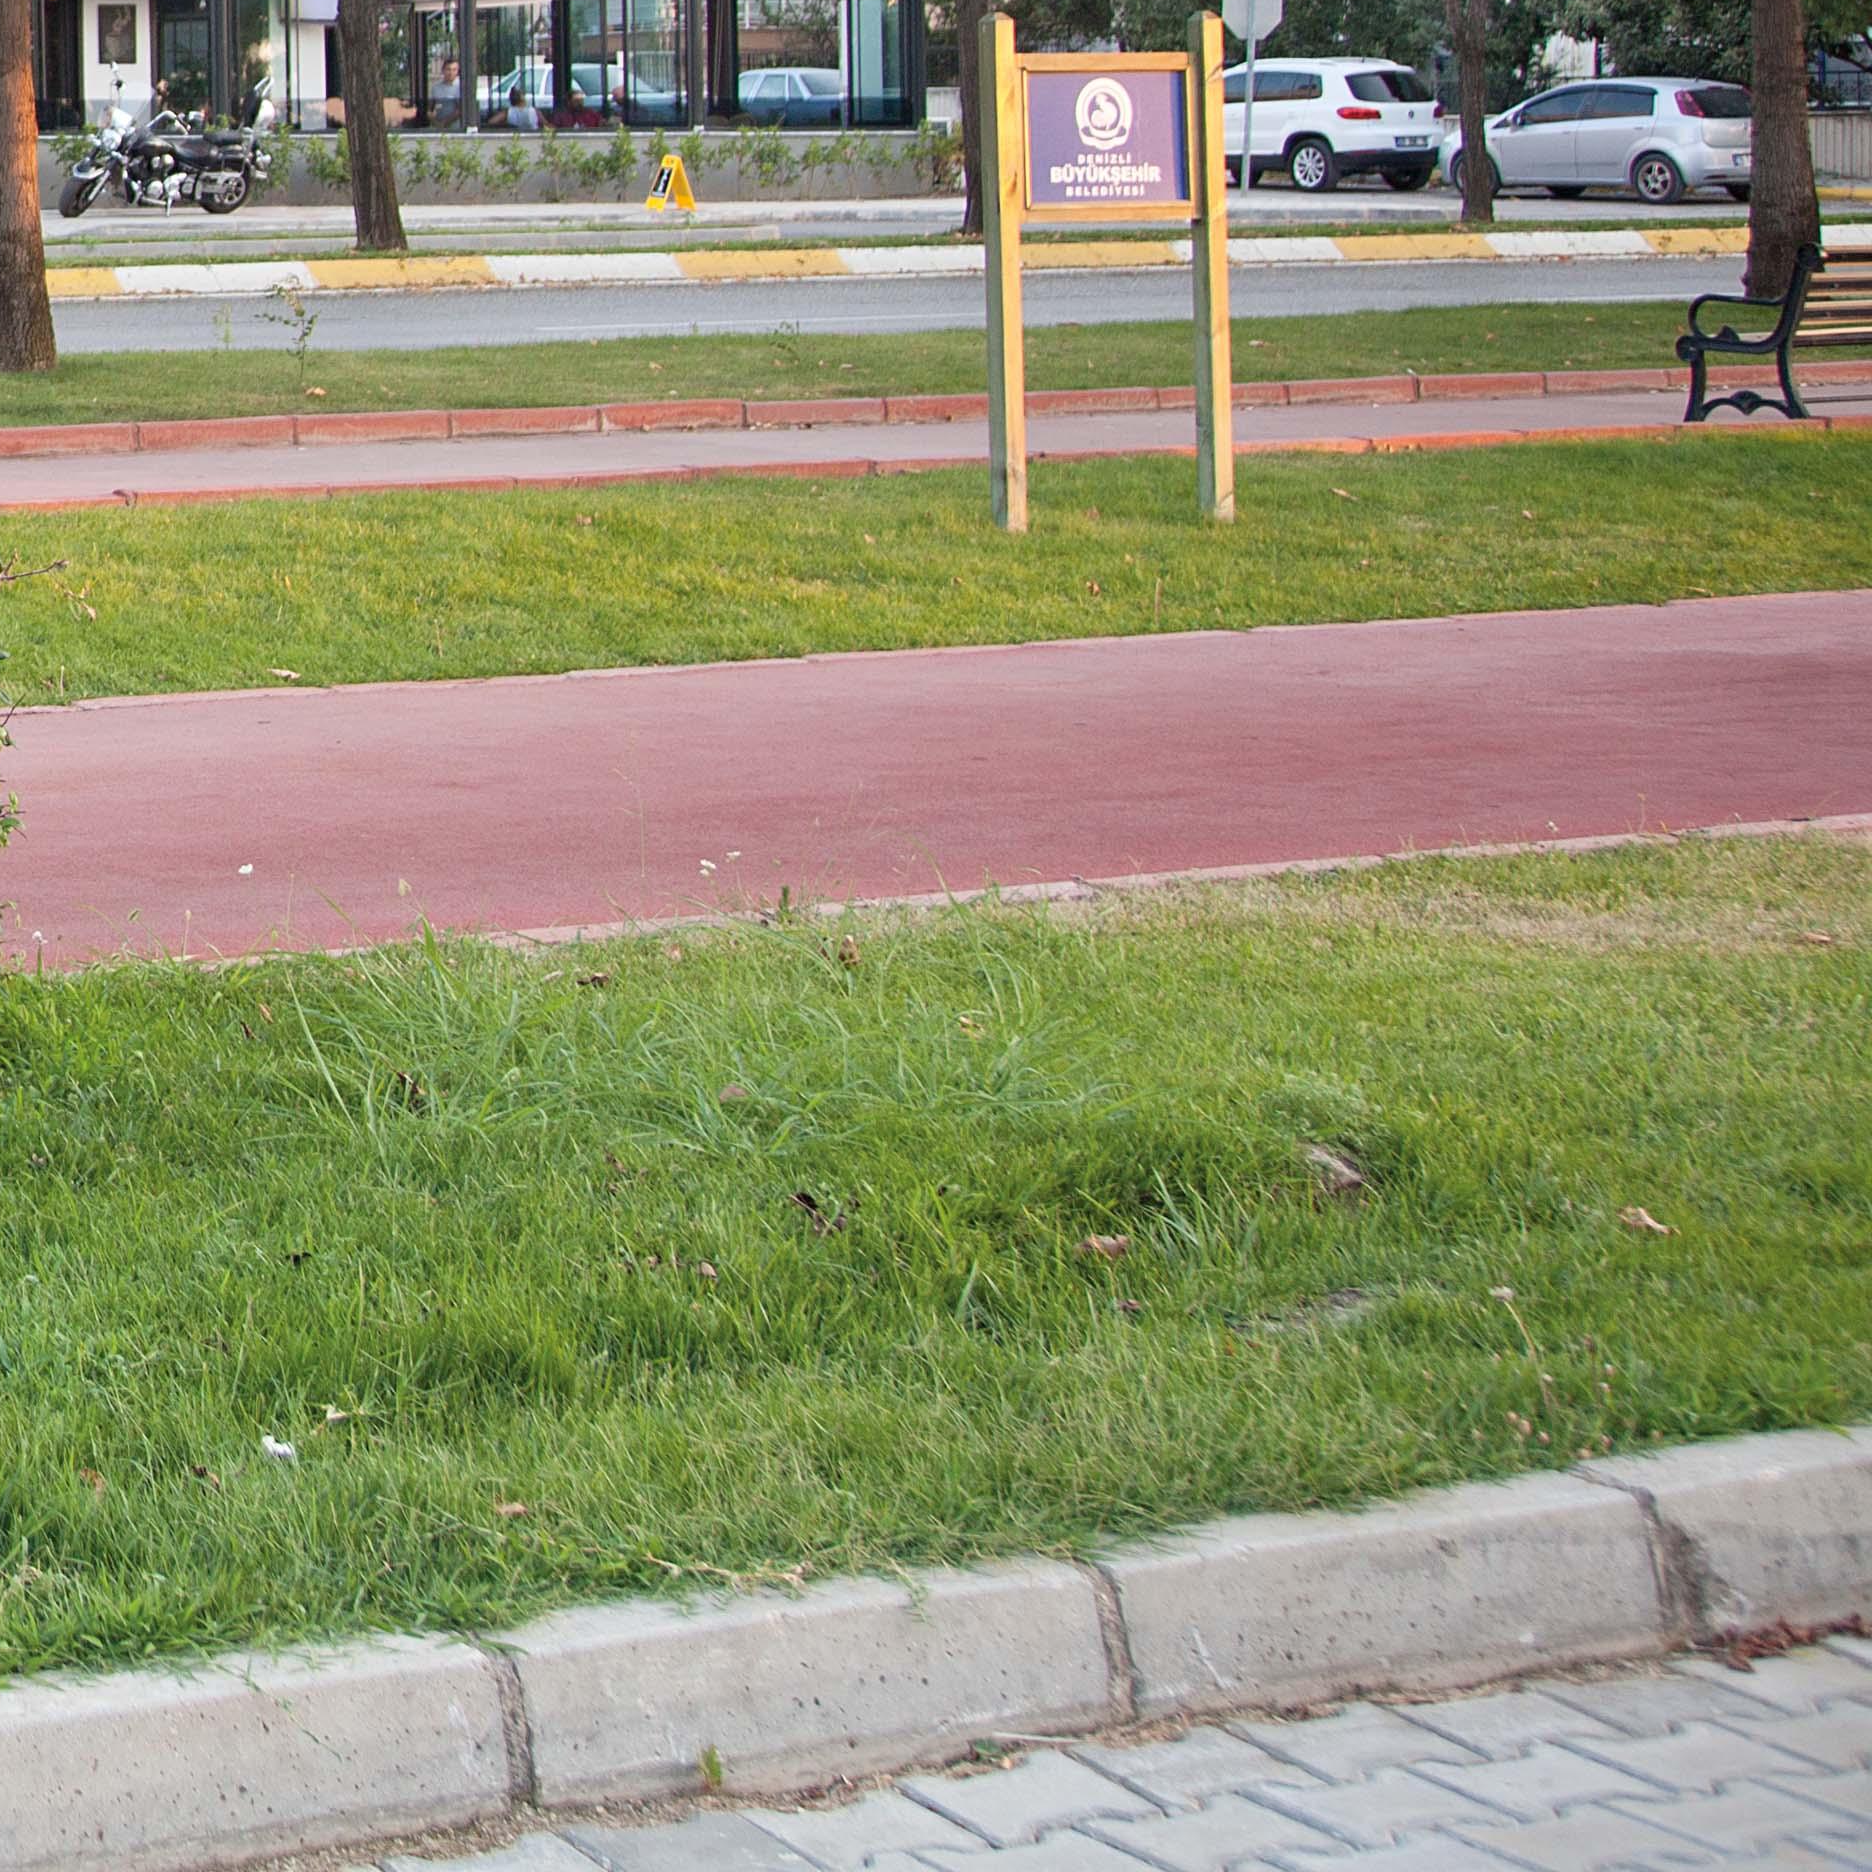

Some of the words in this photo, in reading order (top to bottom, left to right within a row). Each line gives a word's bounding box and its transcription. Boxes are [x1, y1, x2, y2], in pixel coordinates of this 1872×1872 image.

[1077, 152, 1132, 165] DENİZLİ
[1050, 162, 1162, 186] BÜYÜKŞEHİR
[1065, 184, 1146, 197] BELEDİYESİ
